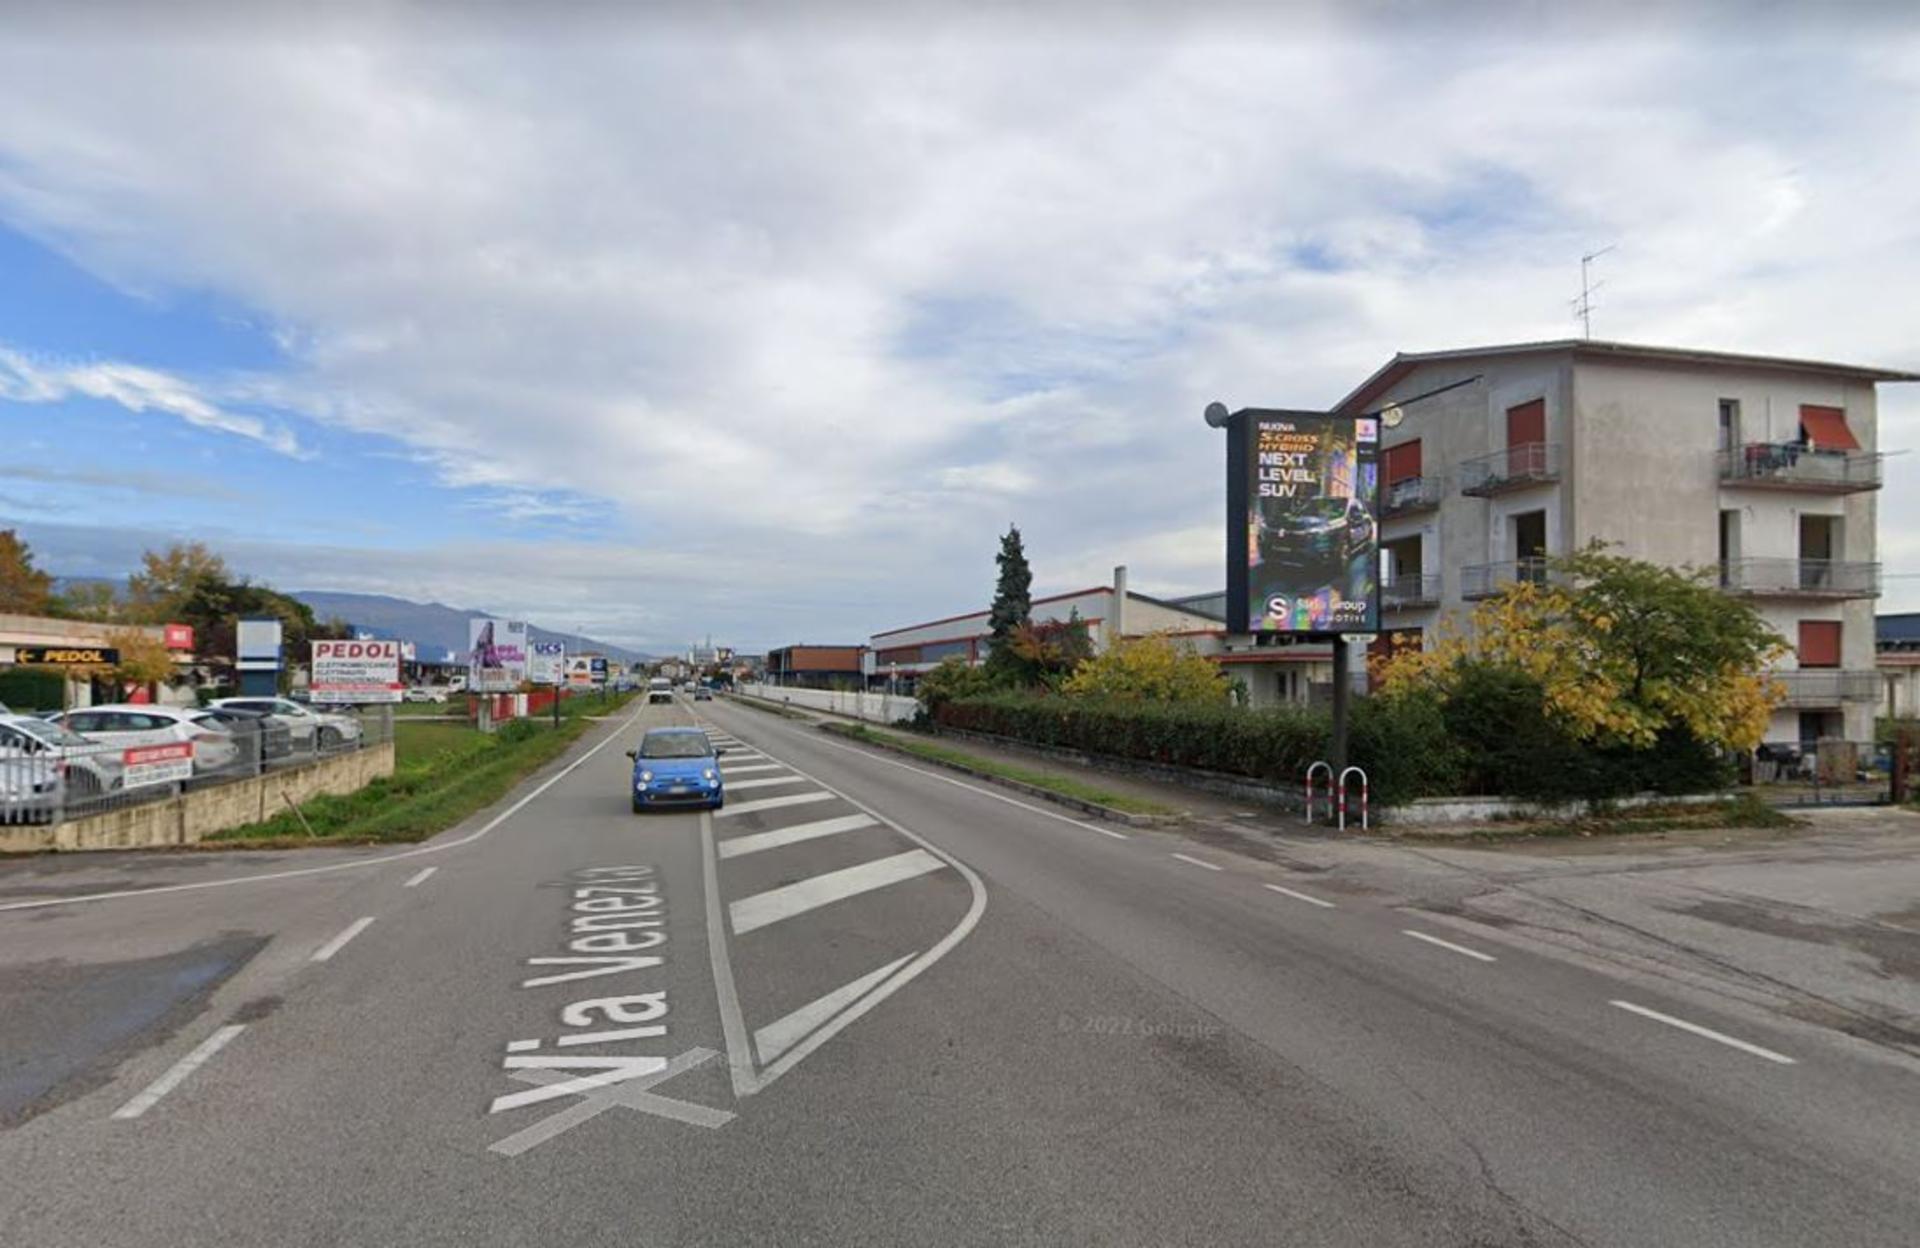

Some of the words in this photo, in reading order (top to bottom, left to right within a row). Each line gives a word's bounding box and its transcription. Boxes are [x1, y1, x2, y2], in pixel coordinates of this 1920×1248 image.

[1259, 452, 1307, 466] NEXT
[1259, 468, 1316, 482] LEVEL
[1259, 483, 1297, 497] SUV
[316, 643, 395, 658] PEDOL
[534, 642, 562, 656] UCS
[43, 651, 104, 662] PEDOL
